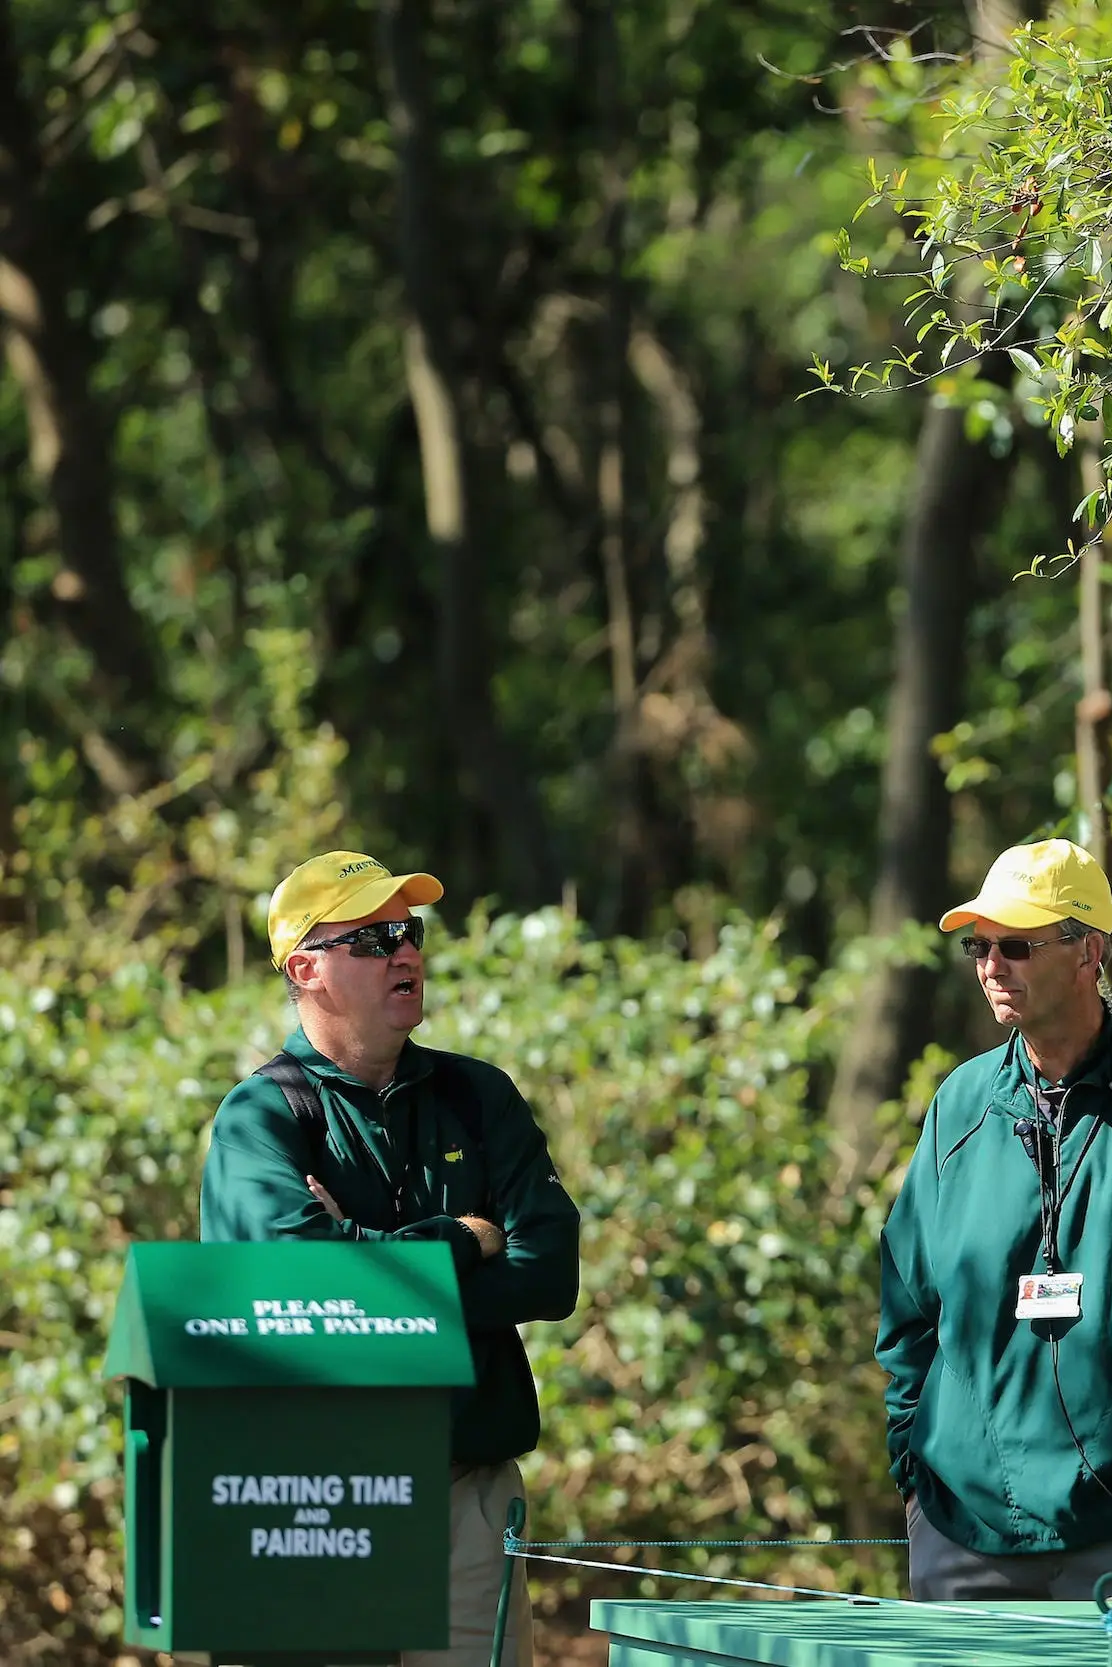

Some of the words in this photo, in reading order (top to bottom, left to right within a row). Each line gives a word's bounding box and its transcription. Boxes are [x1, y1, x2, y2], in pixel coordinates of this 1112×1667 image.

[1071, 899, 1094, 911] GALLERY
[184, 1318, 249, 1336] ONE
[257, 1318, 315, 1335] PER
[323, 1317, 438, 1335] PATRON
[211, 1474, 344, 1505] STARTING
[349, 1475, 413, 1505] TIME
[293, 1508, 331, 1525] AND
[250, 1527, 372, 1558] PAIRINGS
